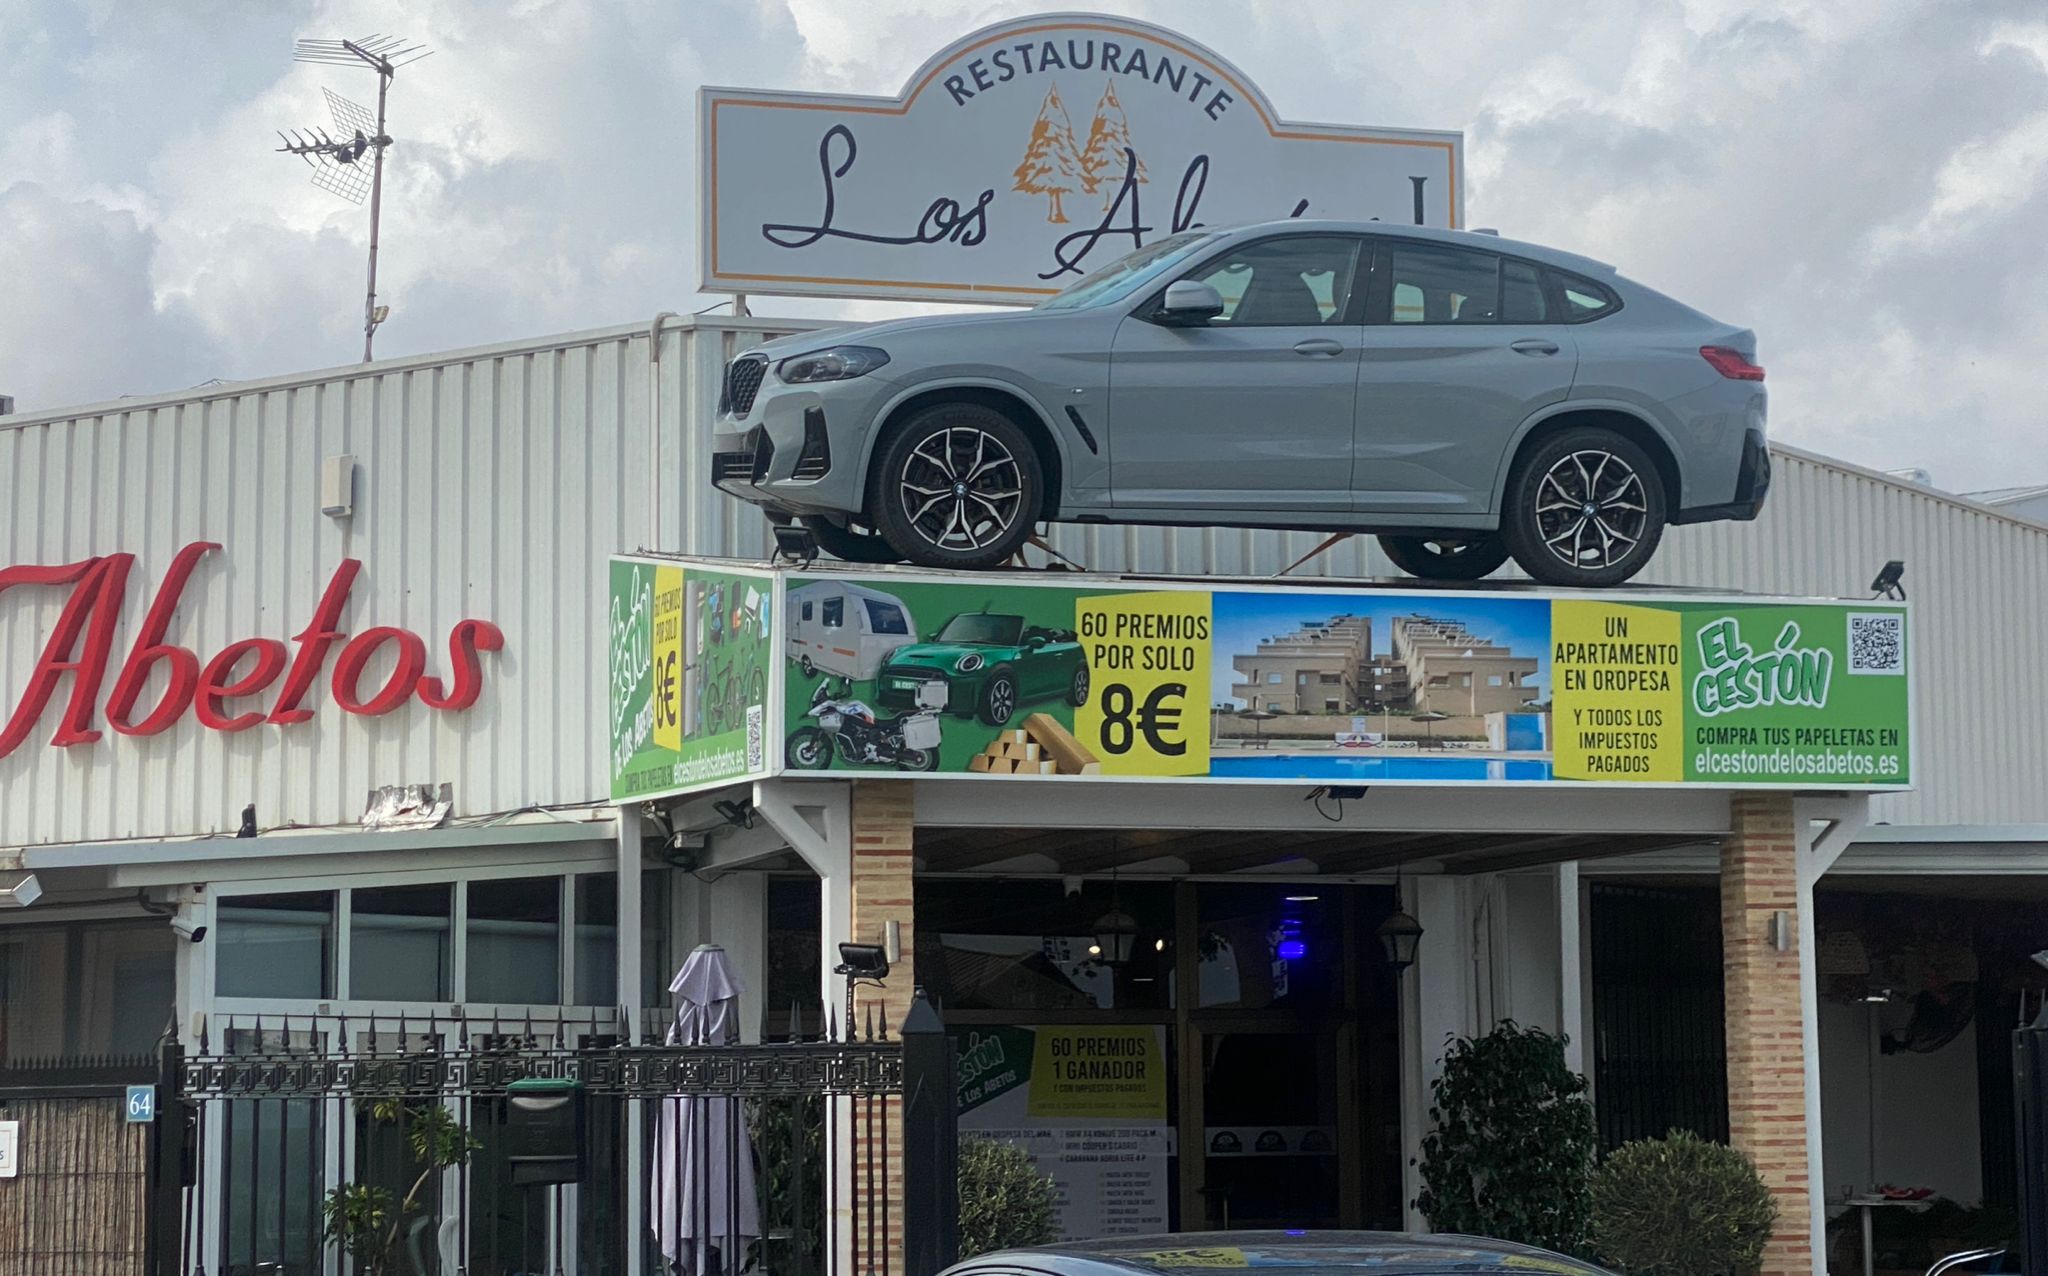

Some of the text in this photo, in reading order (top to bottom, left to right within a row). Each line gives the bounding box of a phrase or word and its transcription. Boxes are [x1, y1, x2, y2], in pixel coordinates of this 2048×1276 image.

[944, 39, 1234, 122] RESTAURANTE
[762, 124, 996, 248] Los
[1081, 612, 1209, 641] 60 PREMIOS
[1605, 616, 1628, 638] UN
[0, 541, 505, 760] Abetos
[1554, 642, 1679, 666] APARTAMENTO
[1697, 616, 1751, 671] EL
[1094, 644, 1195, 672] POR SOLO
[1693, 620, 1833, 718] CESTÓN
[656, 650, 677, 729] 8€
[1565, 669, 1671, 692] EN OROPESA
[1099, 682, 1188, 757] 8€
[1573, 709, 1663, 728] Y TODOS LOS
[1579, 731, 1658, 751] IMPUESTOS
[1696, 727, 1899, 748] COMPRA TUS PAPELETAS EN
[1587, 754, 1650, 774] PAGADOS
[1695, 747, 1900, 776] elcestondelosabetos.es
[1051, 1037, 1146, 1057] 60 PREMIOS
[1053, 1060, 1146, 1080] 1 GANADOR
[129, 1093, 151, 1116] 64
